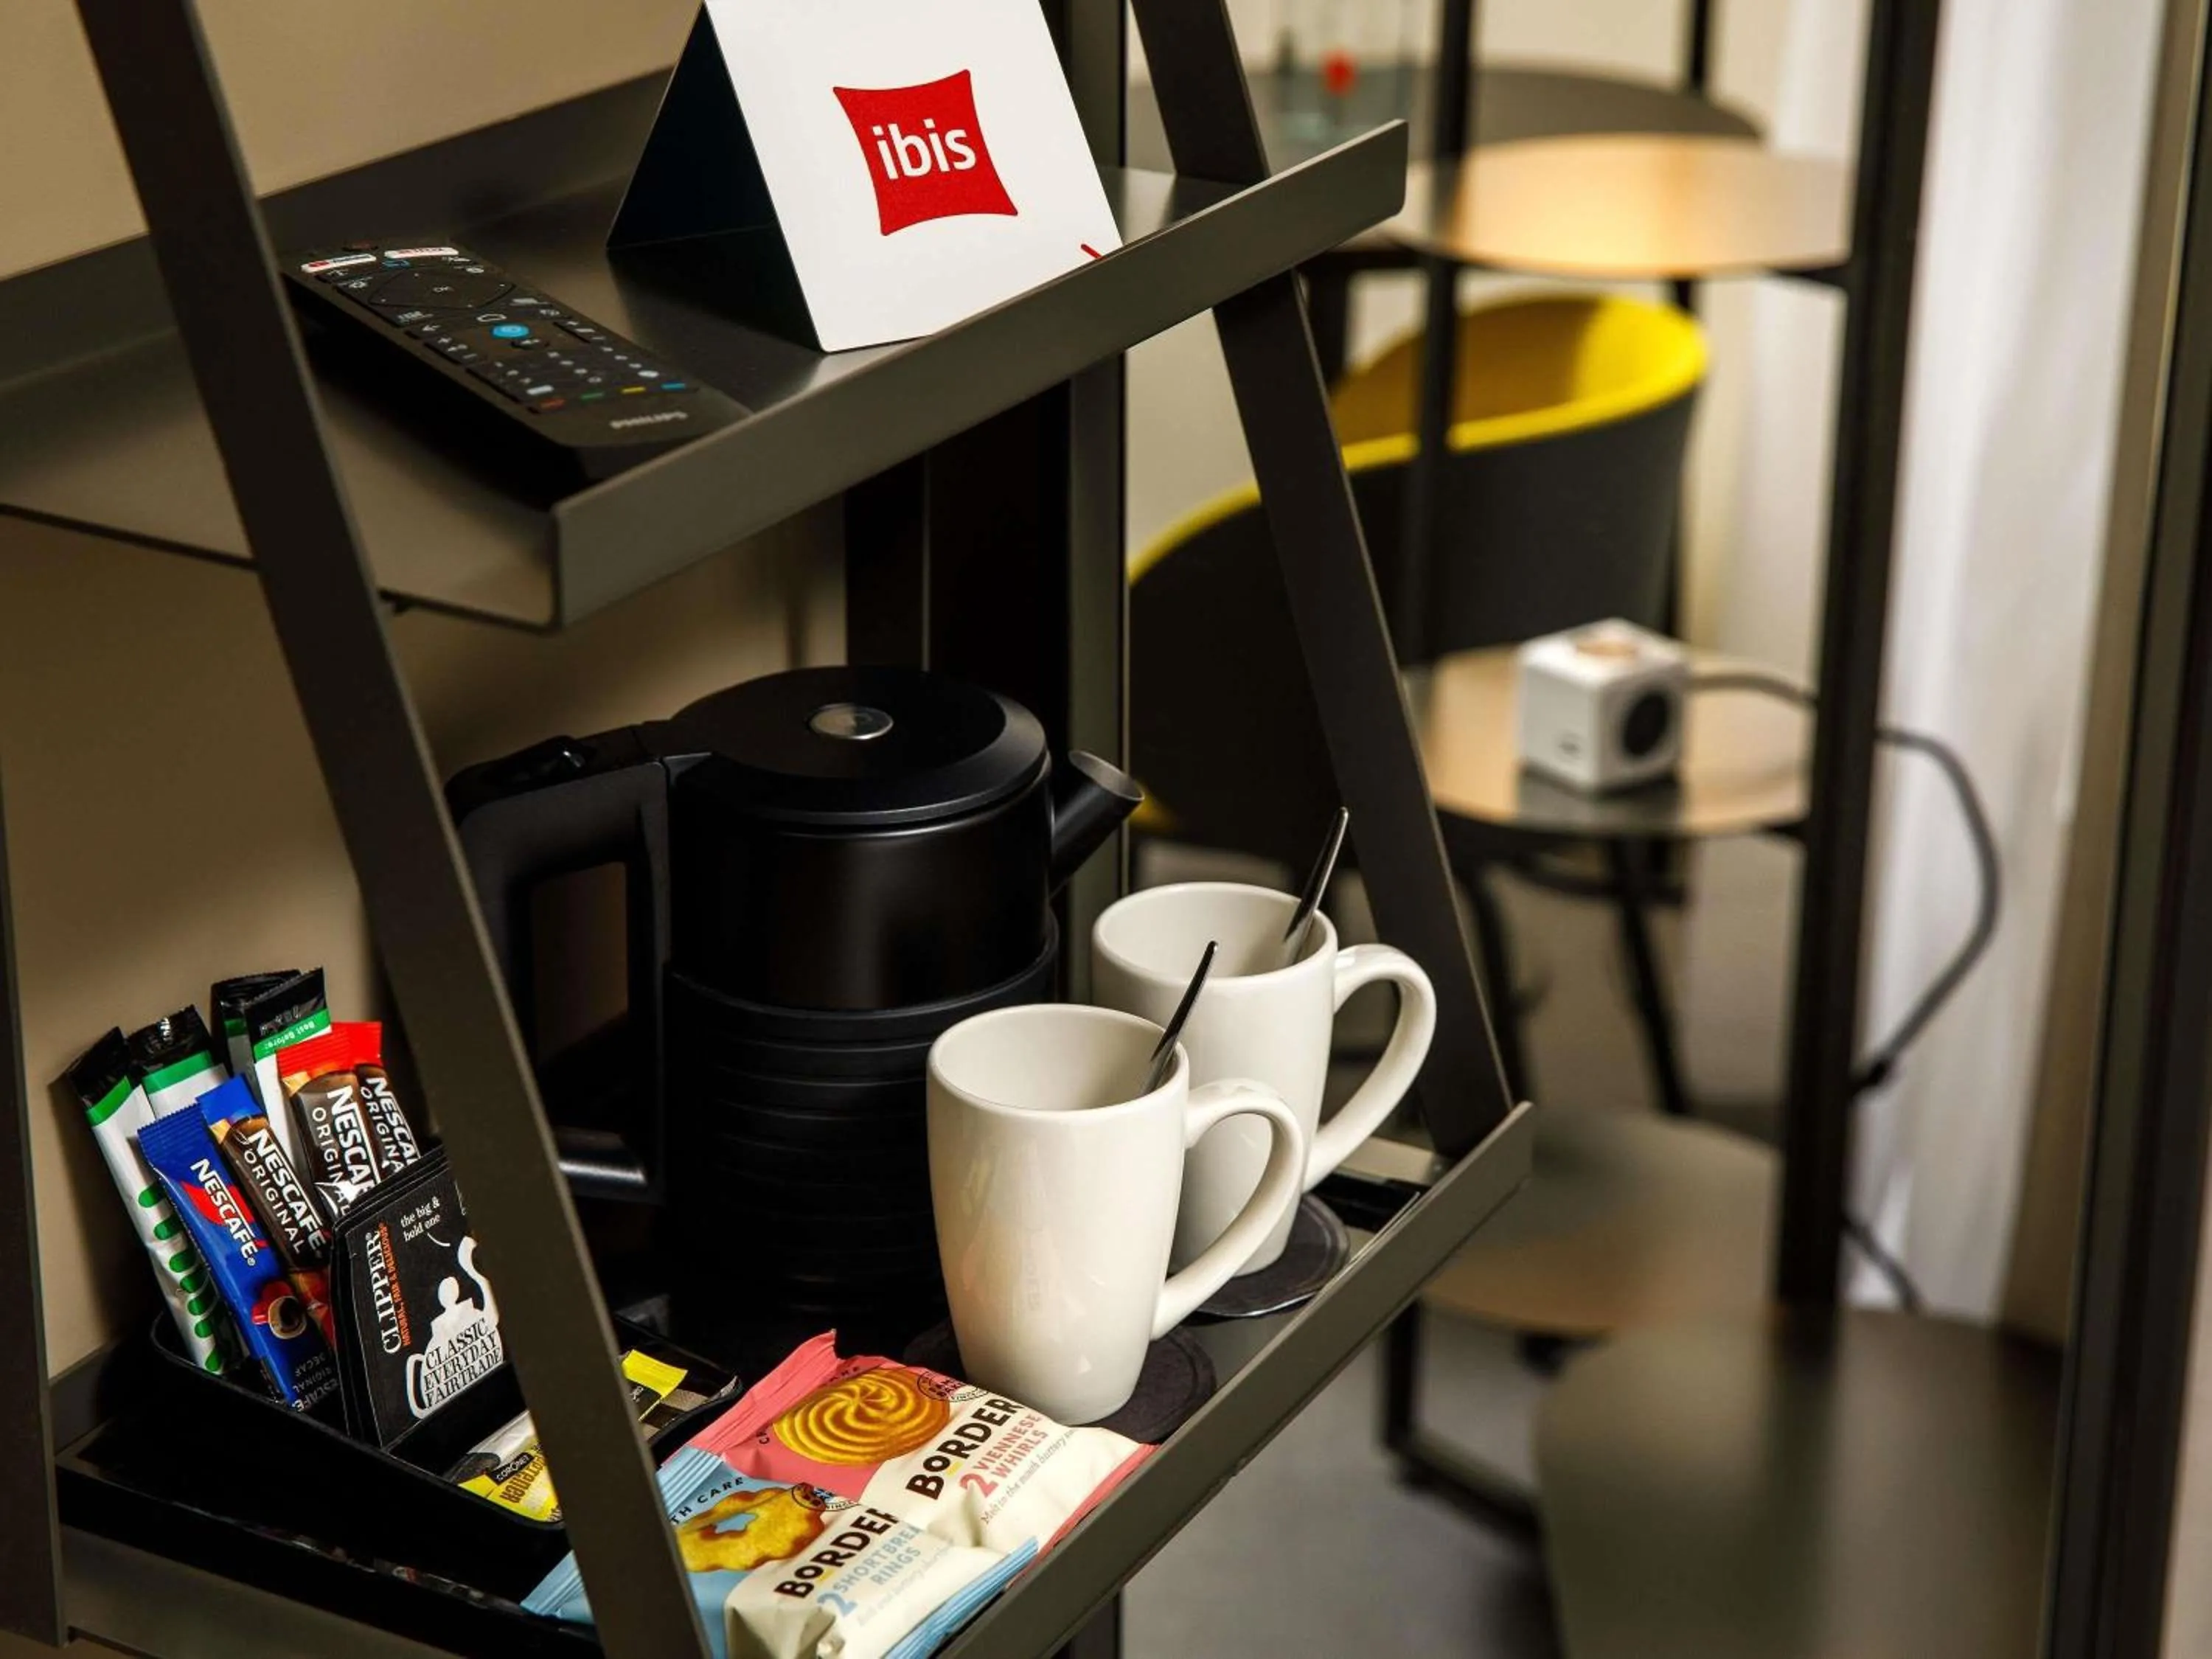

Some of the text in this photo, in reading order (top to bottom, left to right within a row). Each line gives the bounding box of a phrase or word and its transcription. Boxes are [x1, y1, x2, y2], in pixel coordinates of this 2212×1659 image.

[872, 119, 976, 180] ibis
[365, 1077, 421, 1166] NESCA
[312, 1107, 351, 1216] ORIGINAL
[243, 1150, 307, 1253] ORIGINAL
[400, 1195, 441, 1228] the big &
[403, 1223, 424, 1242] bold
[366, 1230, 403, 1354] CLIPPER
[424, 1330, 496, 1393] EVERYDAY
[425, 1318, 487, 1371] CLASSIC
[425, 1347, 502, 1409] FAIRTRADE
[905, 1398, 1026, 1500] BORDER
[959, 1414, 1043, 1498] 2 VIENNESE
[990, 1429, 1049, 1480] WHIRLS
[698, 1477, 744, 1504] CARE
[869, 1545, 921, 1586] RINGS
[816, 1591, 858, 1618] 2
